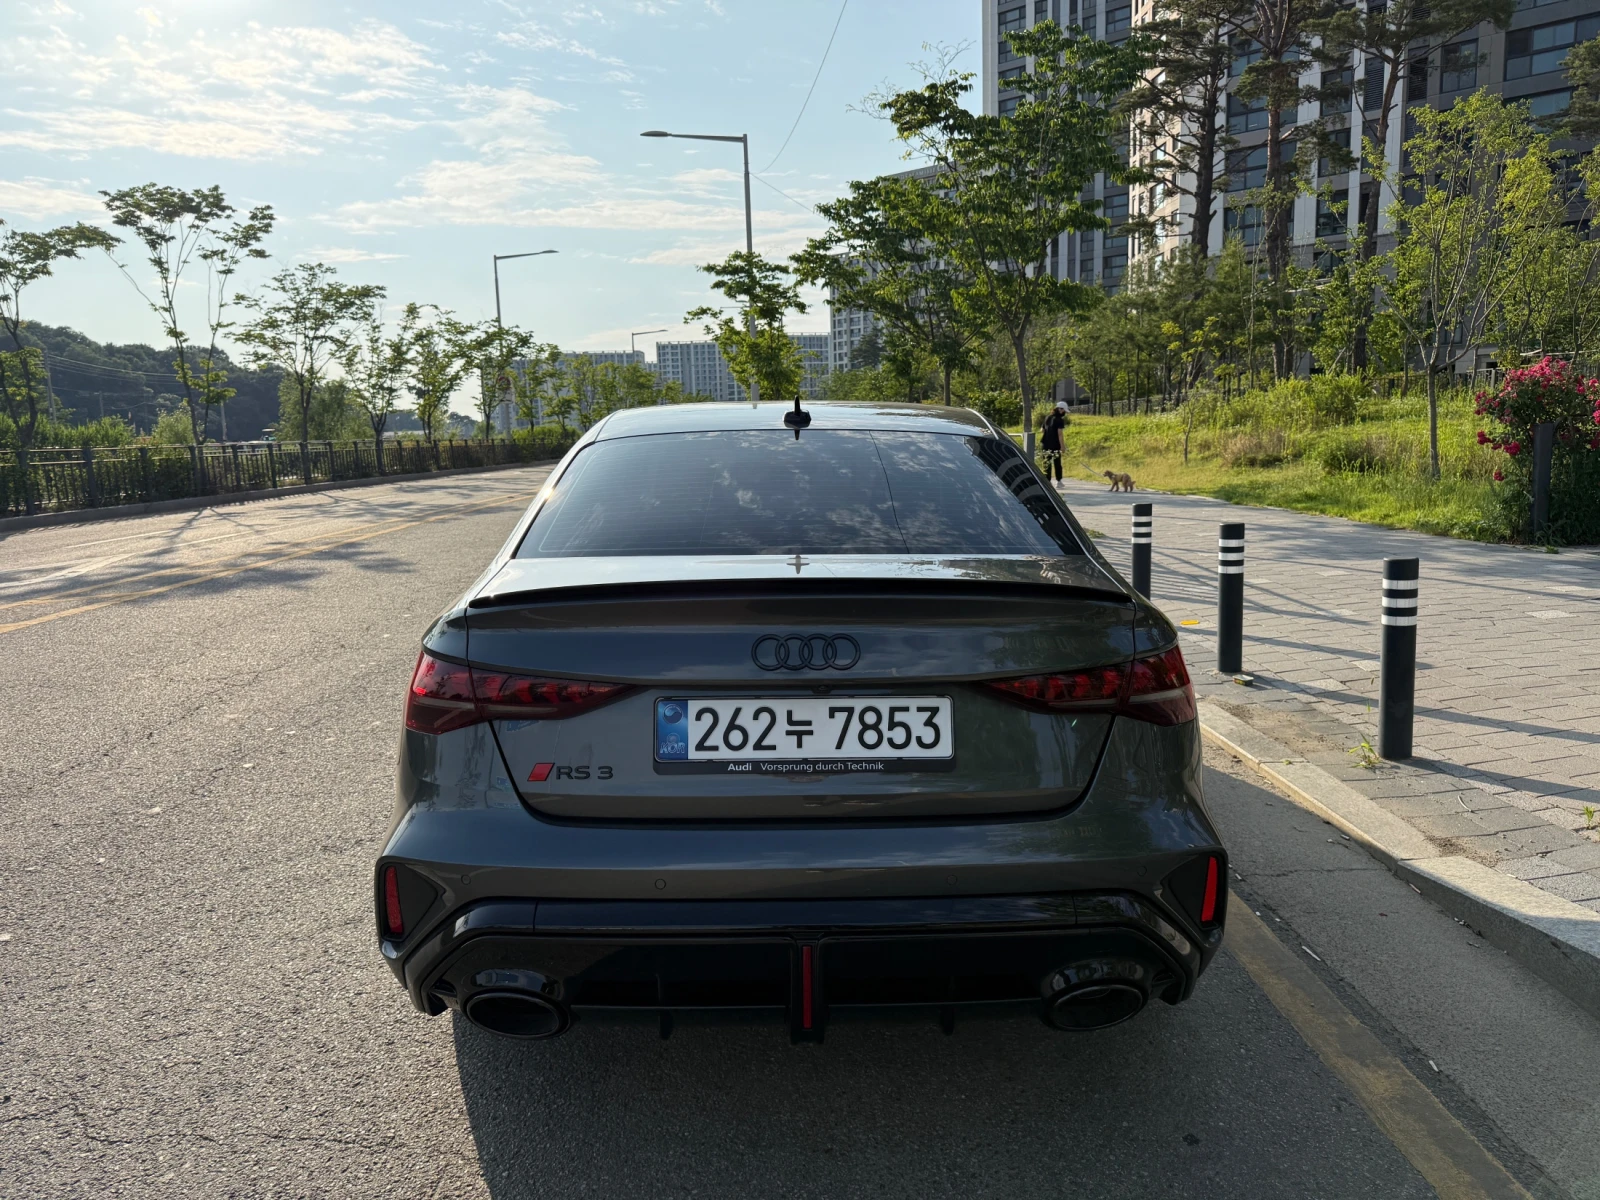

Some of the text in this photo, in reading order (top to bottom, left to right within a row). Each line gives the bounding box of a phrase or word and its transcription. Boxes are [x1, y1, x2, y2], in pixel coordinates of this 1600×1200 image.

[695, 706, 941, 751] 262누 7853
[660, 742, 686, 754] KOR
[555, 765, 614, 780] RS 3
[727, 761, 885, 773] Audi Vorsprung durch Technik
